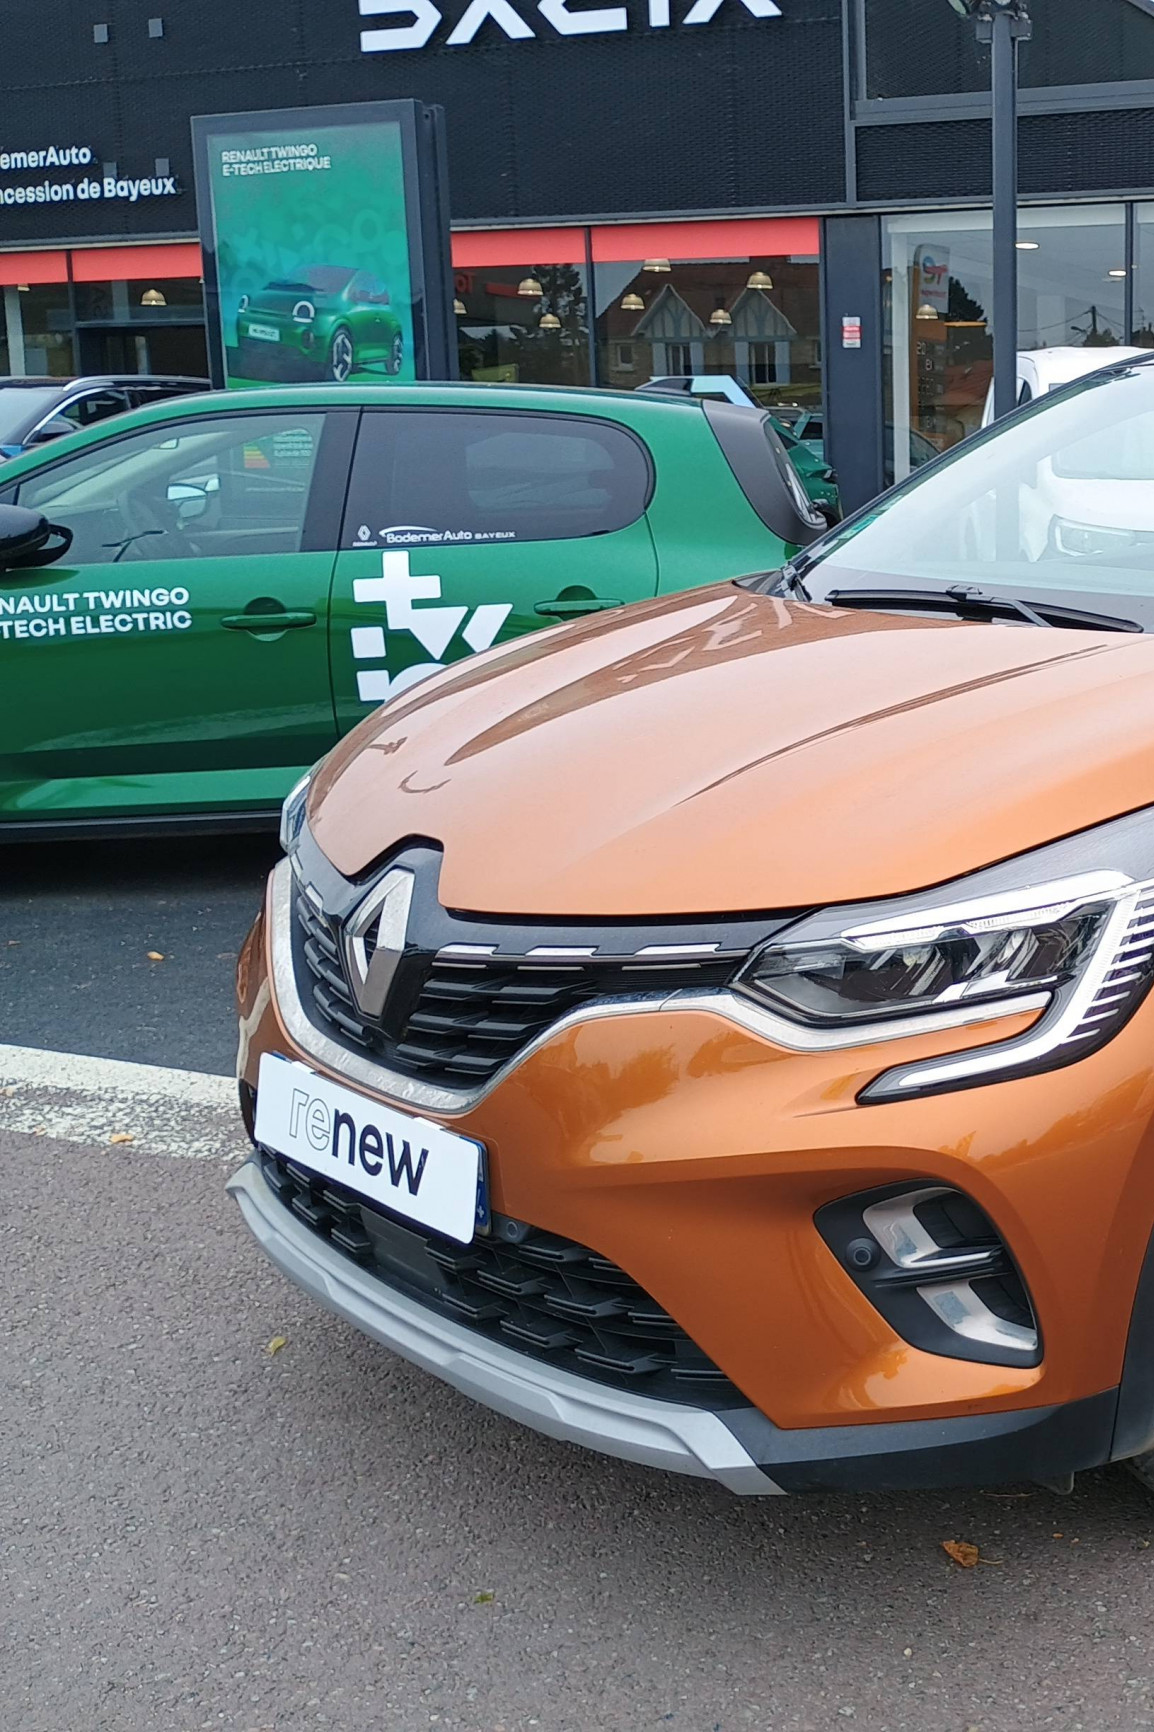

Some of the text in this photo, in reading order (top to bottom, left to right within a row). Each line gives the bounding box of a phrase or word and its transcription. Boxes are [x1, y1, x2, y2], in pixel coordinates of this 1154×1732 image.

[221, 143, 318, 163] RENAULT TWINGO
[222, 156, 332, 177] E-TECH ELECTRIQUE
[76, 177, 101, 200] de
[103, 176, 177, 202] Bayeux
[83, 587, 190, 610] TWINGO
[70, 610, 192, 636] ELECTRIC
[288, 1088, 429, 1196] renew
